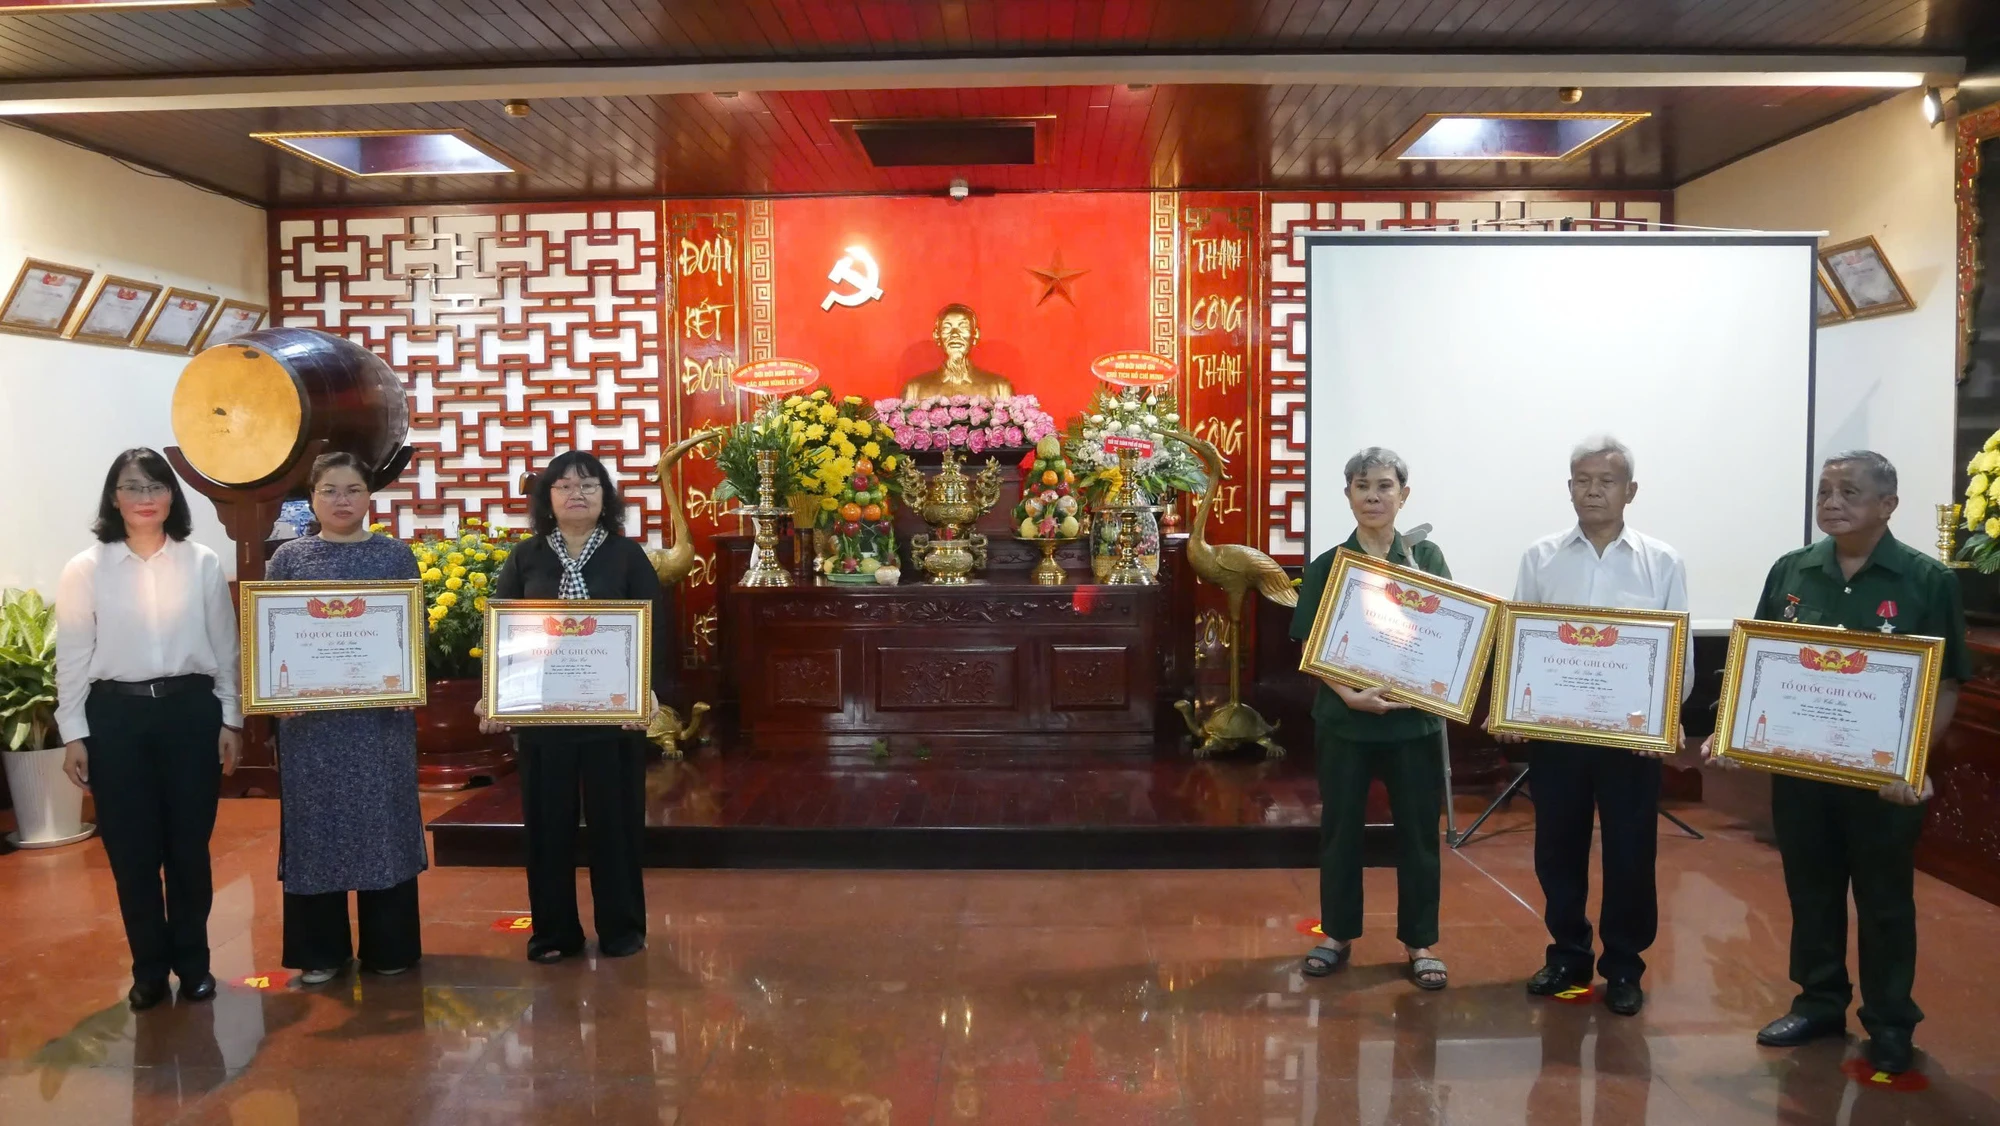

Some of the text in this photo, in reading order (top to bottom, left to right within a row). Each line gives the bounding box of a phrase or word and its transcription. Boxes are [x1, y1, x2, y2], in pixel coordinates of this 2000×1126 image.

[685, 297, 733, 341] KẾT
[1191, 294, 1244, 333] CÔNG
[688, 552, 716, 588] ĐO
[336, 630, 352, 638] GHI
[692, 605, 718, 646] KẾ
[568, 648, 583, 656] GHI
[1583, 659, 1600, 668] GHI
[1826, 686, 1845, 697] GHI
